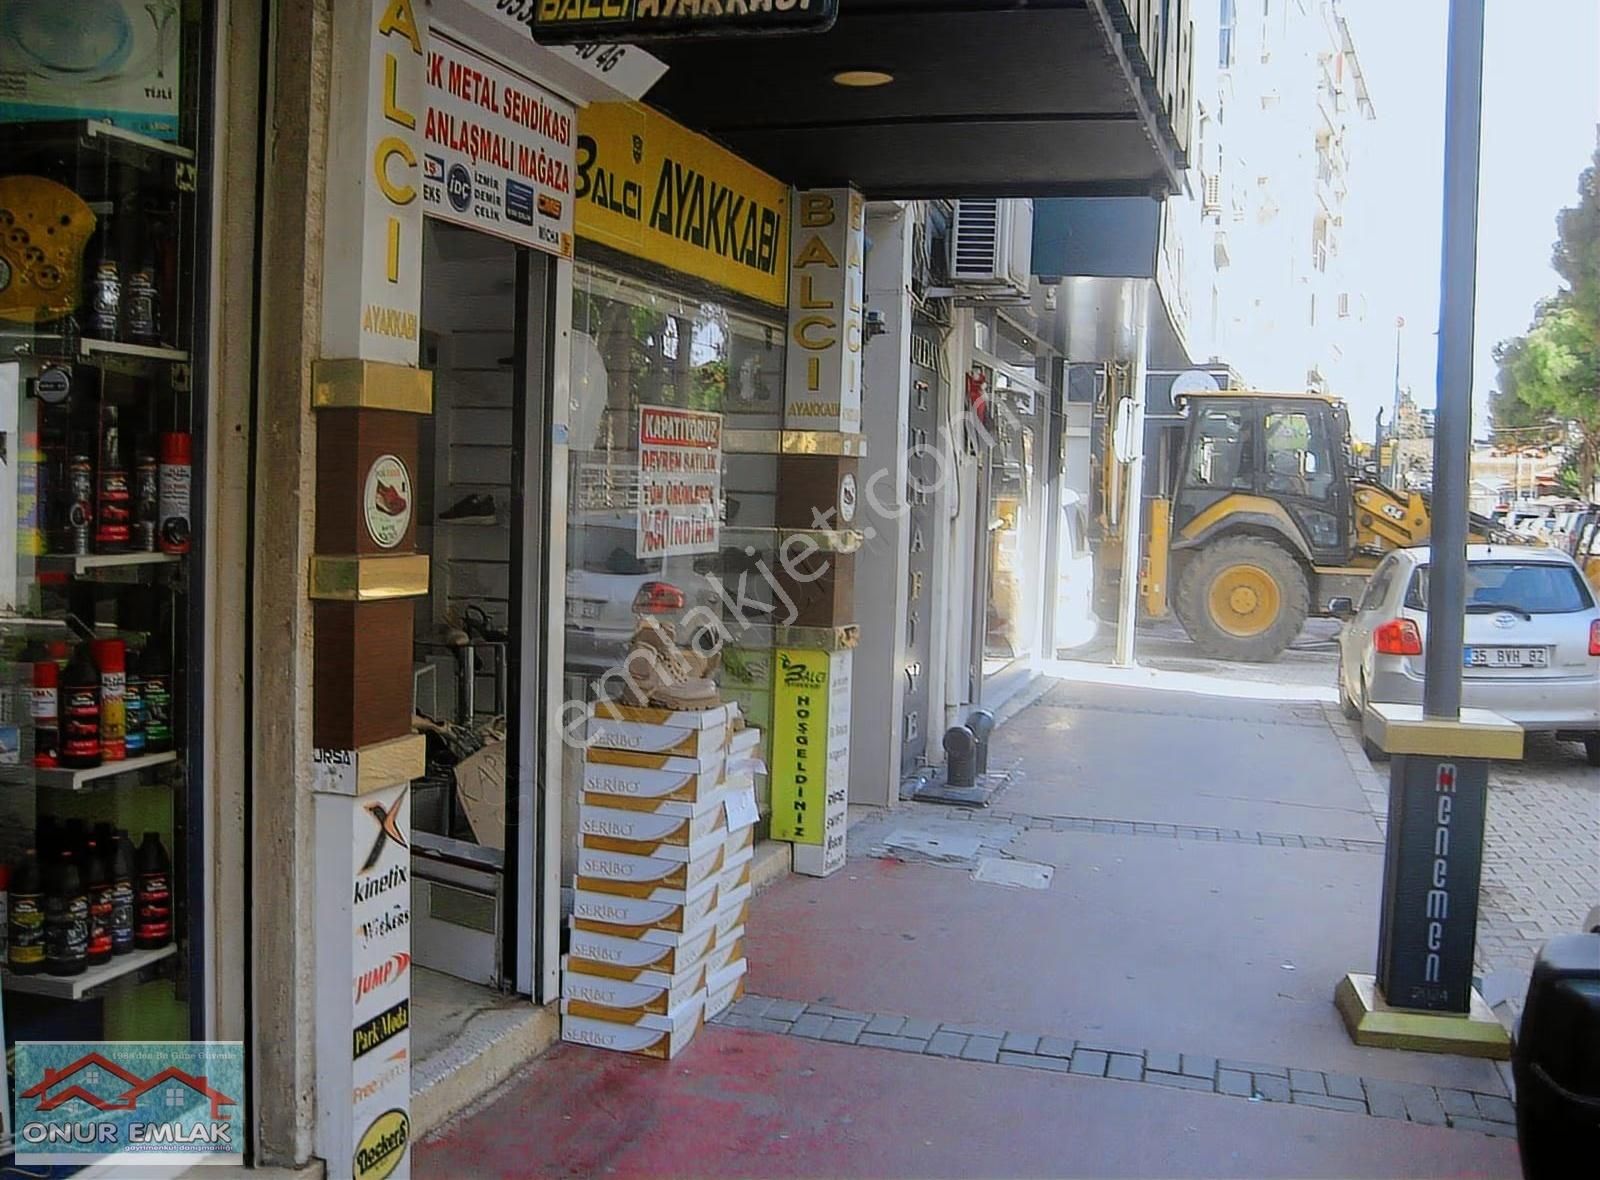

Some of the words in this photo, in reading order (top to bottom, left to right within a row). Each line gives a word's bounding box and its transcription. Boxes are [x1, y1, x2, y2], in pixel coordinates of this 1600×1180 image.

[448, 60, 499, 114] METAL
[503, 87, 571, 147] SENDİKASI
[425, 106, 514, 172] ANLAŞMALI
[518, 143, 570, 194] MAĞAZA
[649, 157, 781, 276] AYAKKABI
[353, 864, 408, 905] kinetix
[355, 1021, 380, 1054] Park
